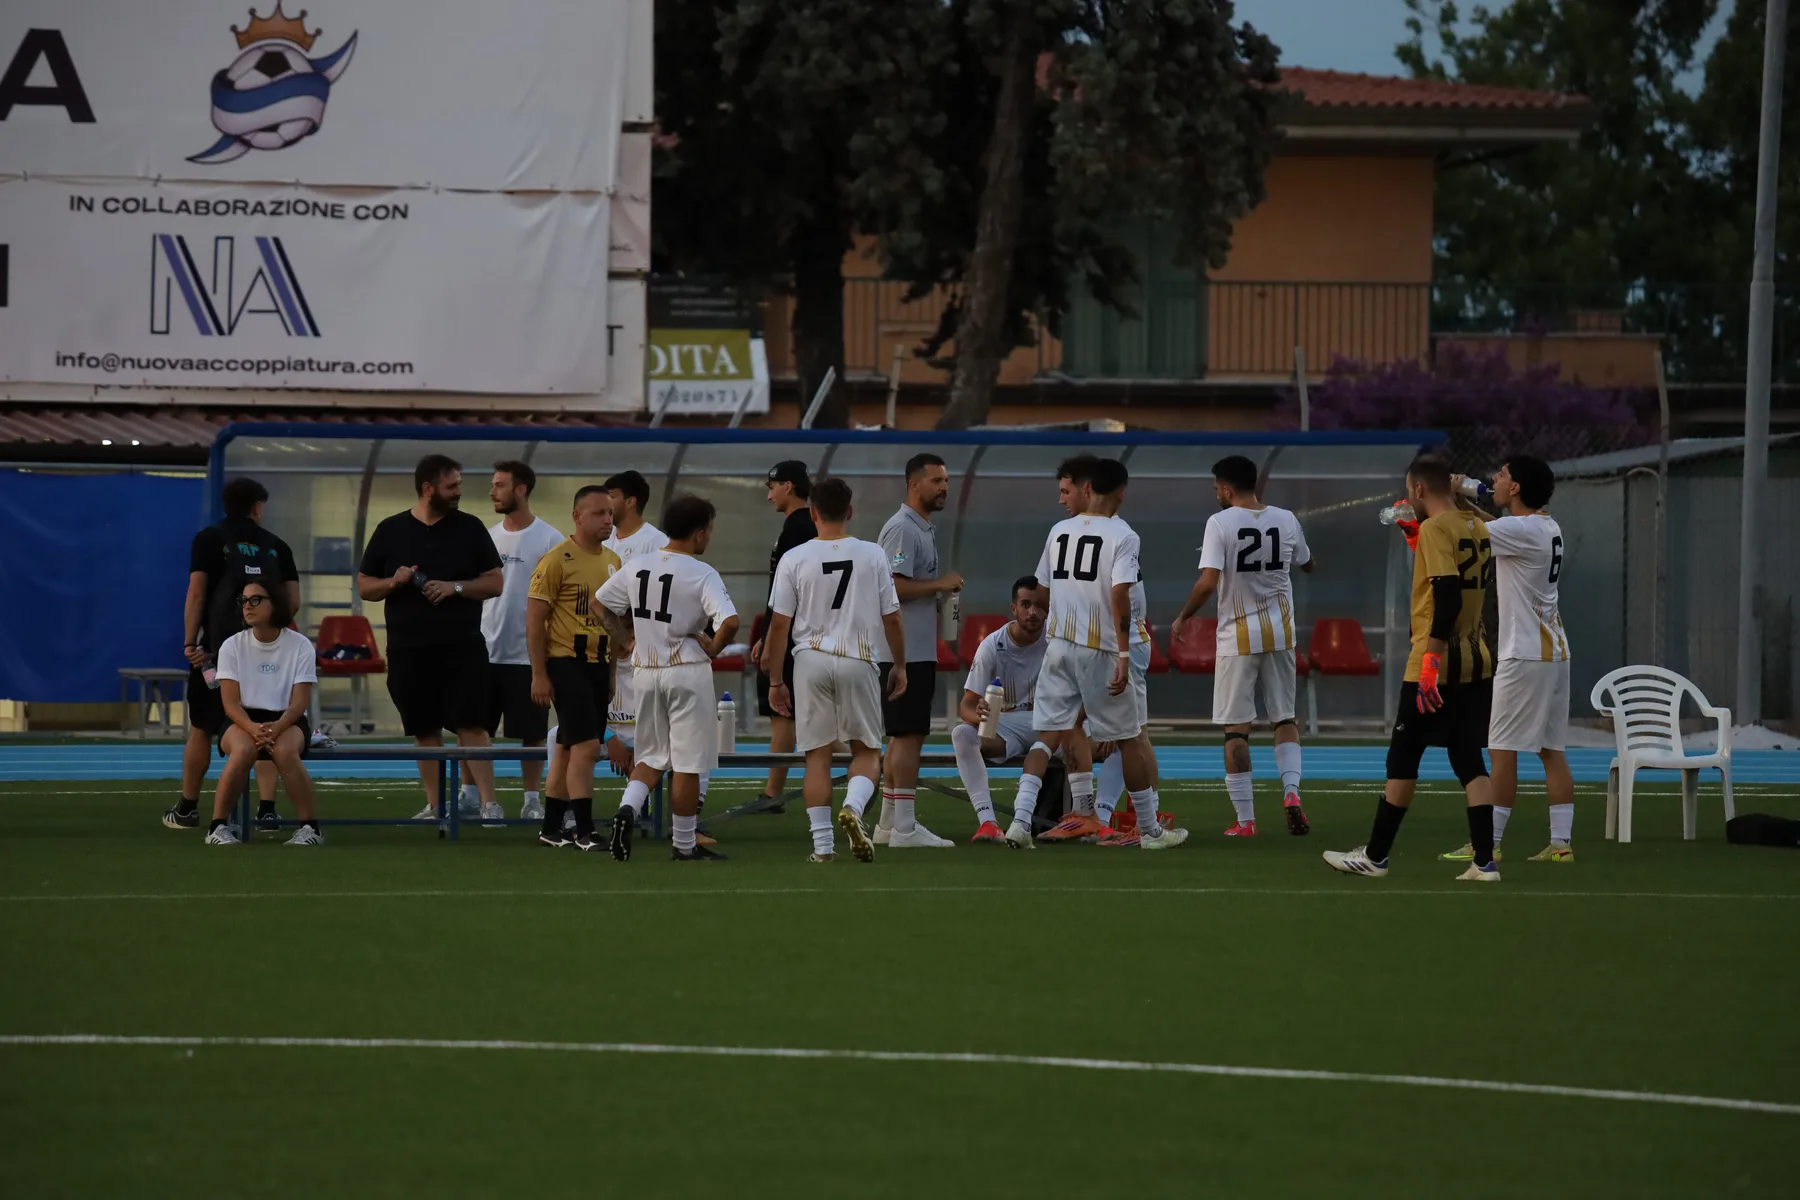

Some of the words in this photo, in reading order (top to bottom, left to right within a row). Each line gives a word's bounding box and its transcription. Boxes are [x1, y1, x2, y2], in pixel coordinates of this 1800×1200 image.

[69, 194, 95, 213] IN
[102, 196, 345, 220] COLLABORAZIONE
[352, 203, 409, 221] CON
[150, 233, 321, 337] NA
[55, 350, 414, 375] info@nuovaaccoppiatura.com
[1053, 533, 1103, 582] 10
[1237, 527, 1284, 573] 21
[1457, 538, 1491, 590] 22
[1551, 536, 1563, 583] 6
[633, 569, 674, 624] 11
[822, 559, 854, 610] 7
